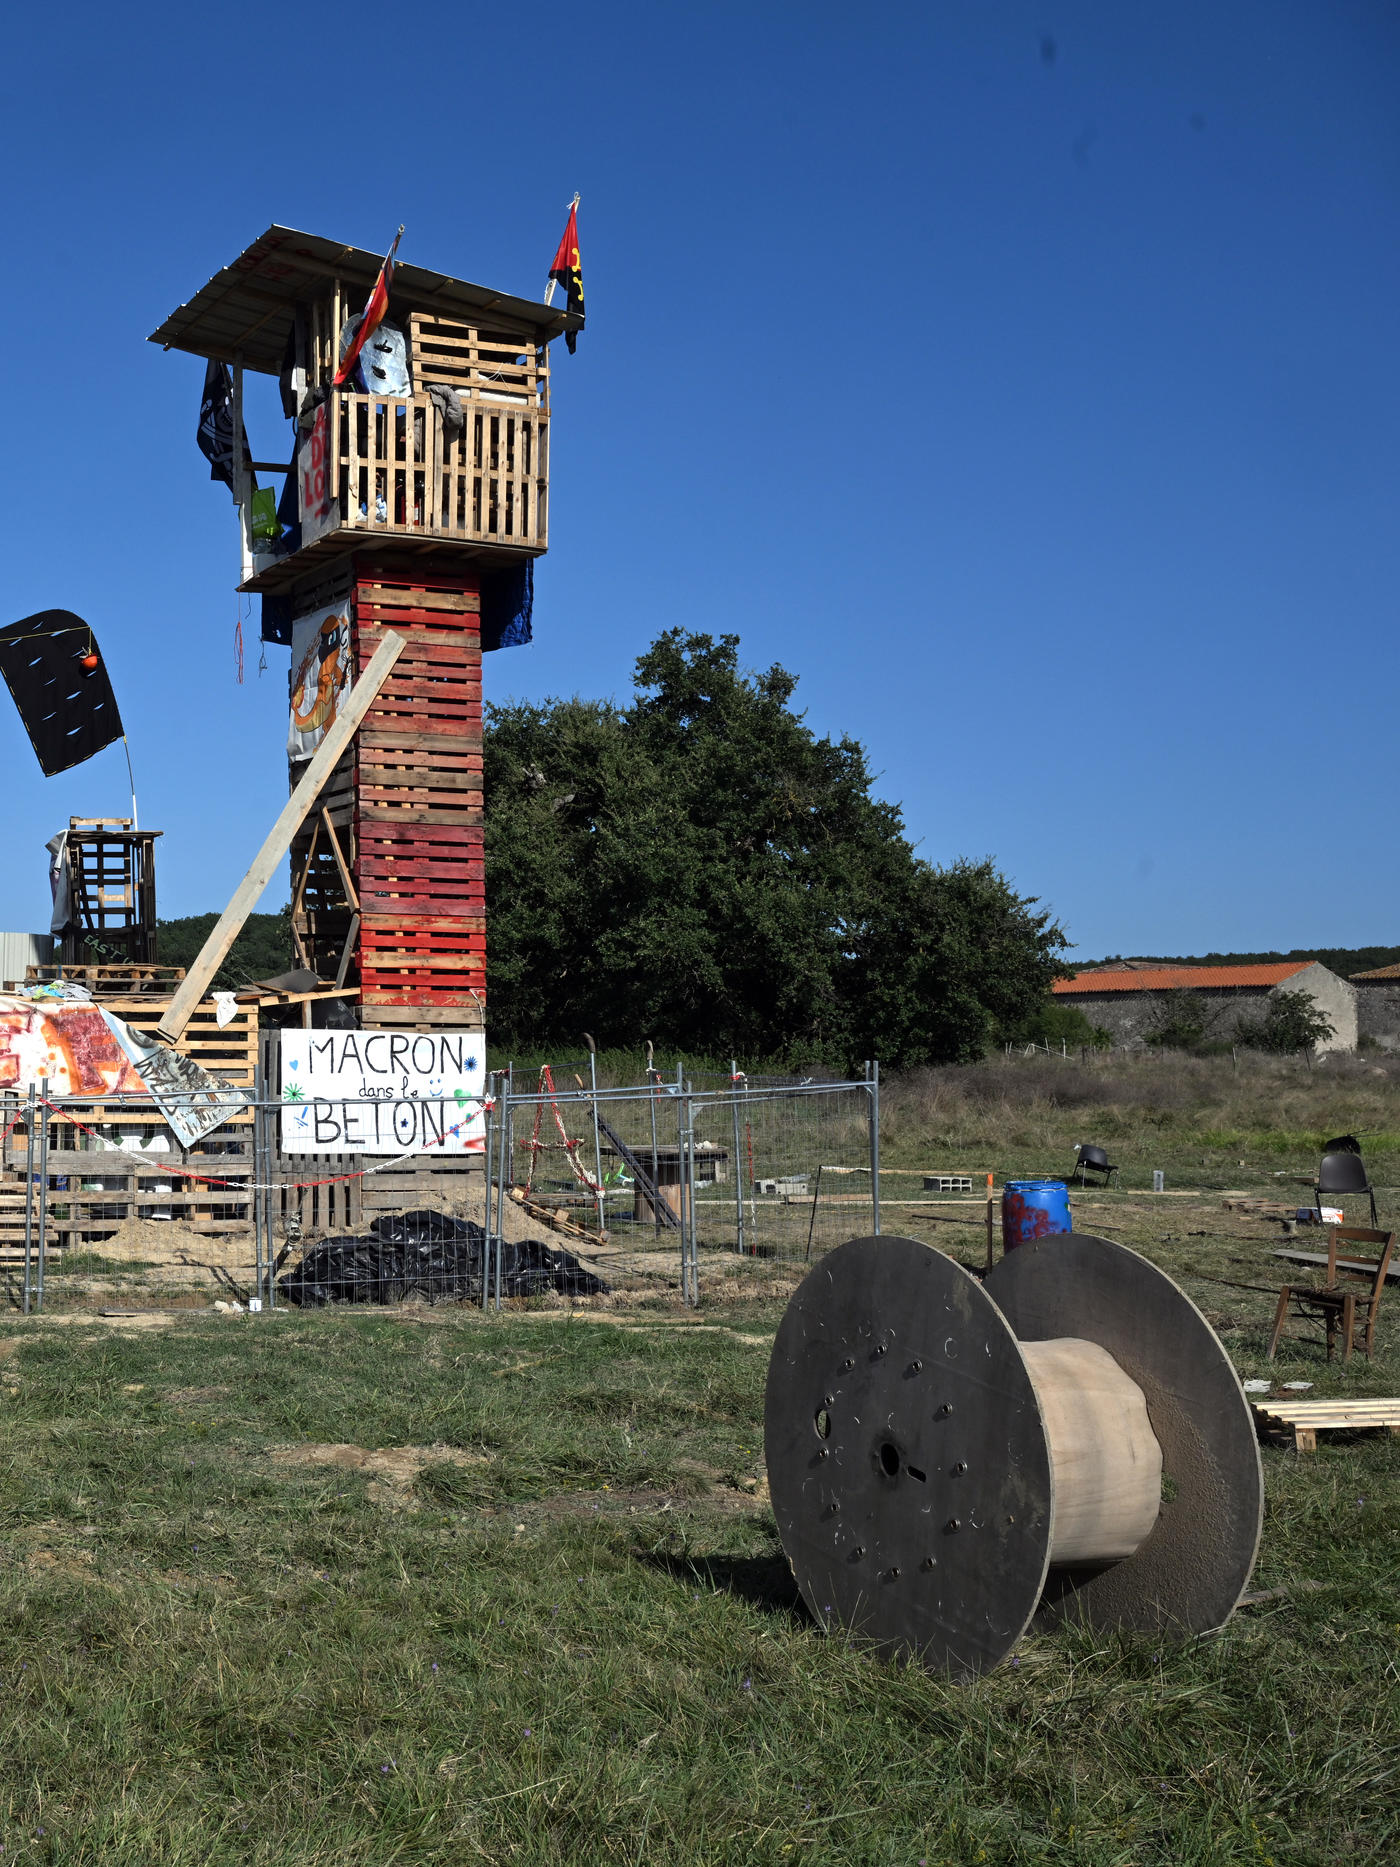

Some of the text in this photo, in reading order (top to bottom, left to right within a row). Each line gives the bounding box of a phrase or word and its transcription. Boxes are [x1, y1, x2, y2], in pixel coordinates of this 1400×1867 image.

[84, 934, 122, 959] EAST
[309, 1034, 463, 1075] MACRON
[359, 1076, 419, 1099] dans le
[314, 1097, 445, 1147] BETON
